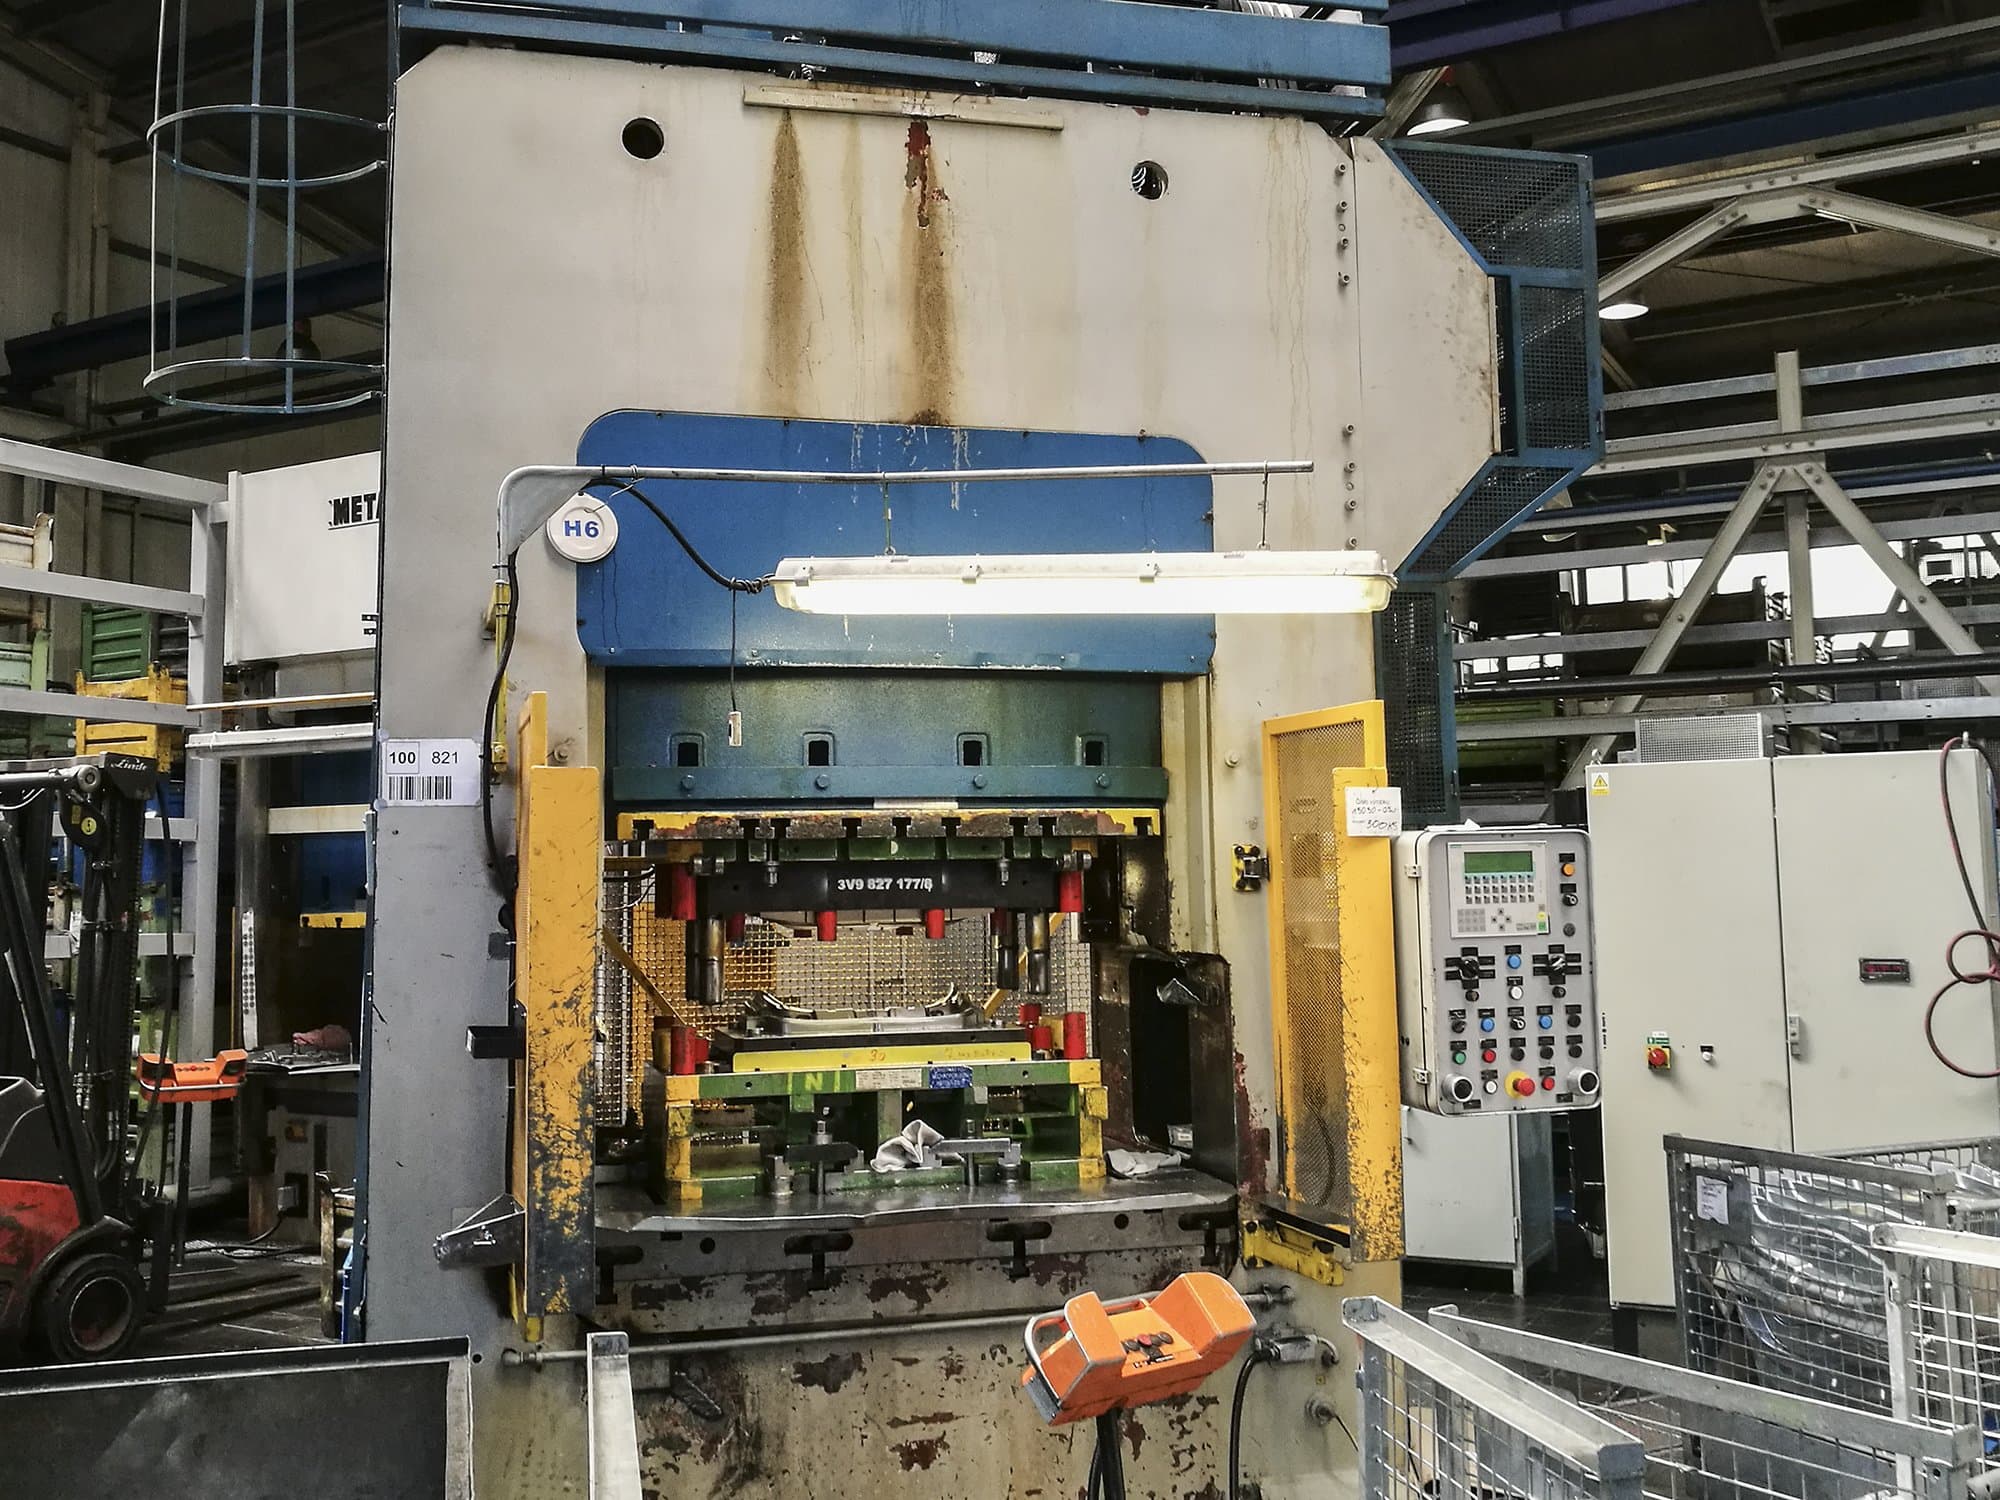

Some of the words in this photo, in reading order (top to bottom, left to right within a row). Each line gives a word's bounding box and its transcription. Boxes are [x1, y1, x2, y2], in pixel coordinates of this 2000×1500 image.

[563, 519, 600, 539] H6
[389, 751, 416, 764] 100
[431, 751, 458, 765] 821
[837, 878, 864, 891] 3V9
[867, 878, 893, 890] 827
